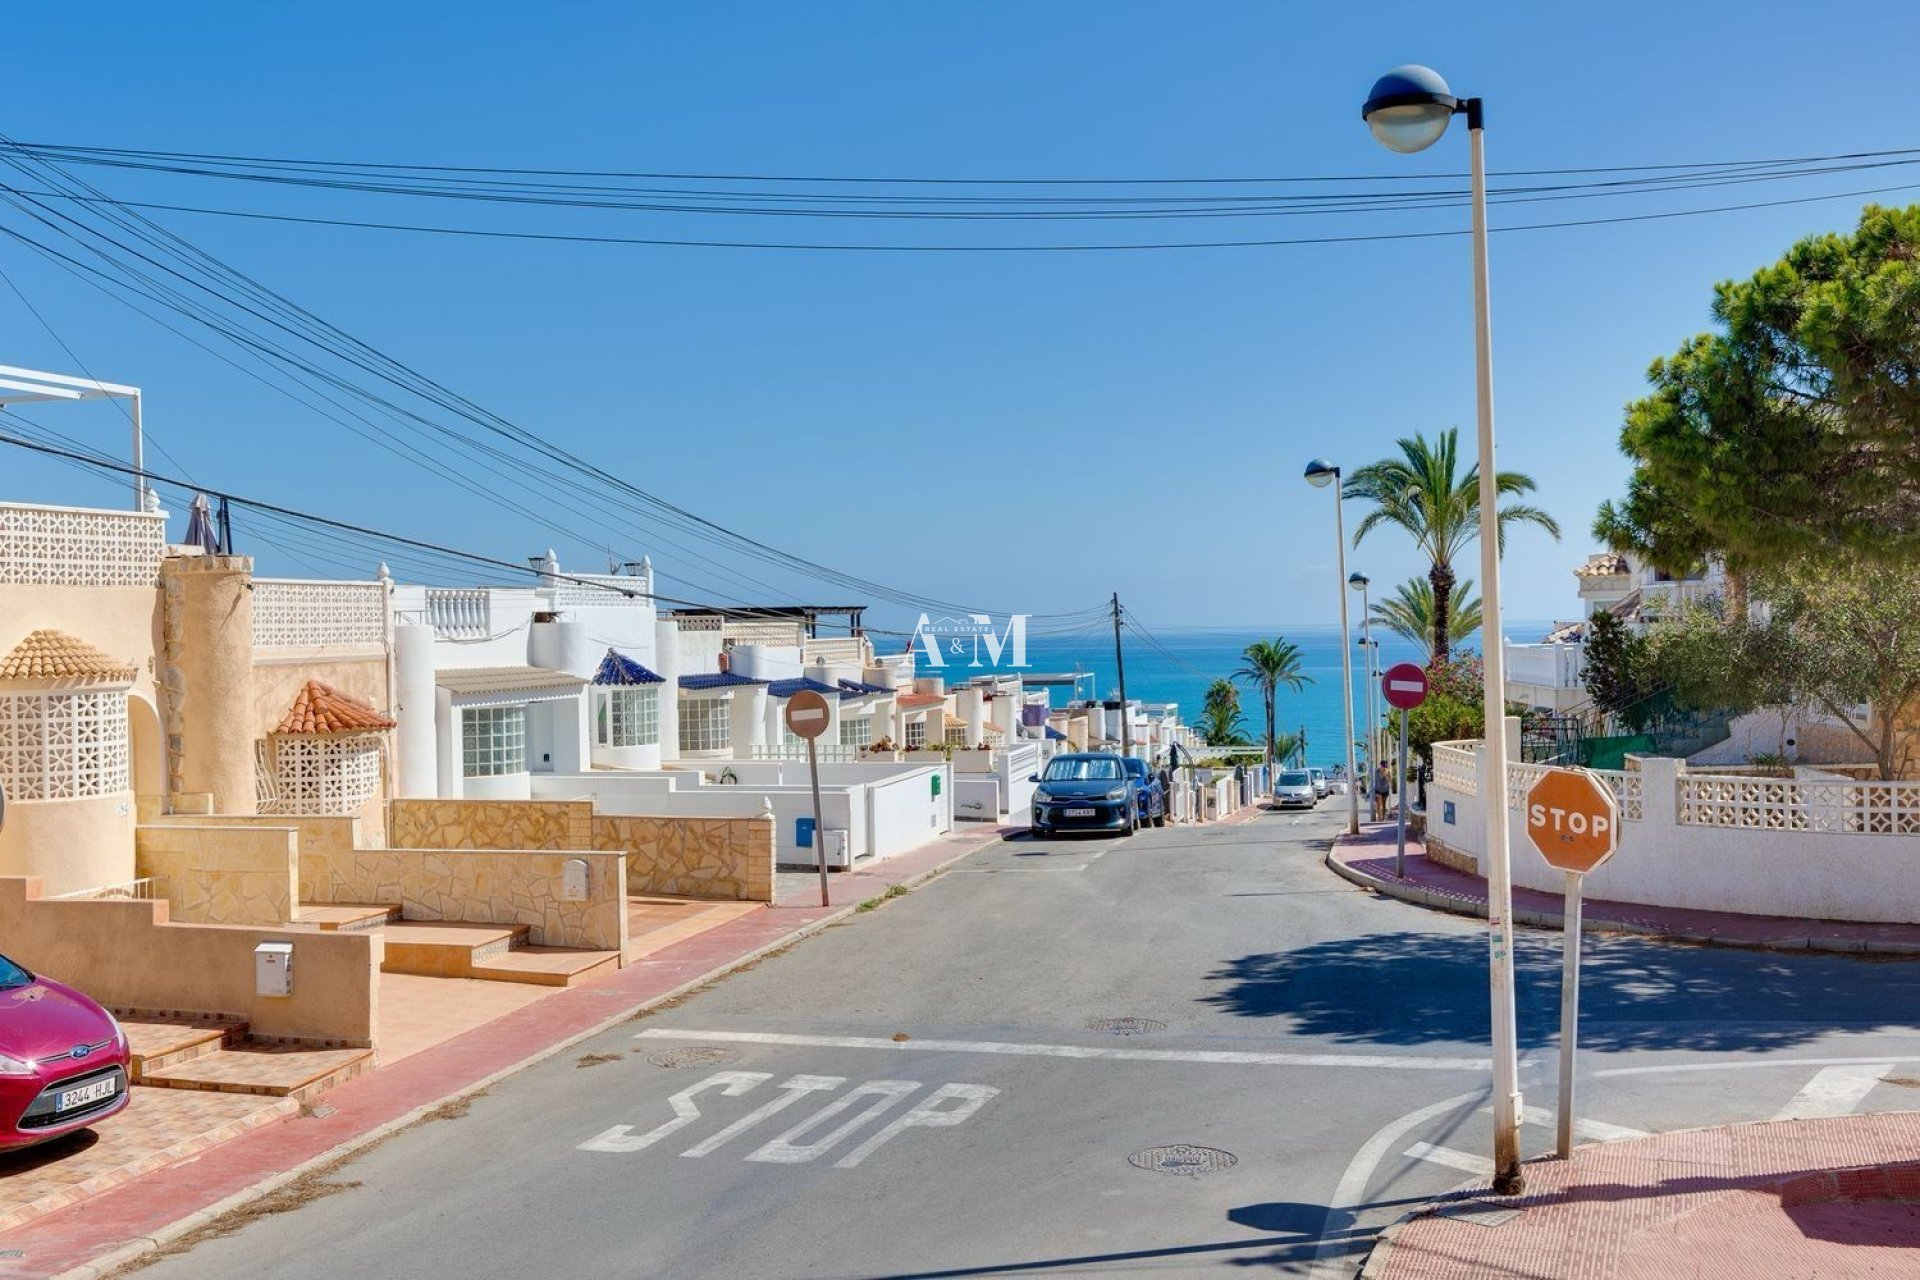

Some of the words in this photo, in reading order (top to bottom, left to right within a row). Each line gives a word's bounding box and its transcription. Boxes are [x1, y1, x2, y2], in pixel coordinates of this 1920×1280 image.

[1530, 803, 1609, 838] STOP
[65, 1087, 91, 1107] 3244
[95, 1080, 113, 1098] HJL
[575, 1070, 1002, 1168] STOP
